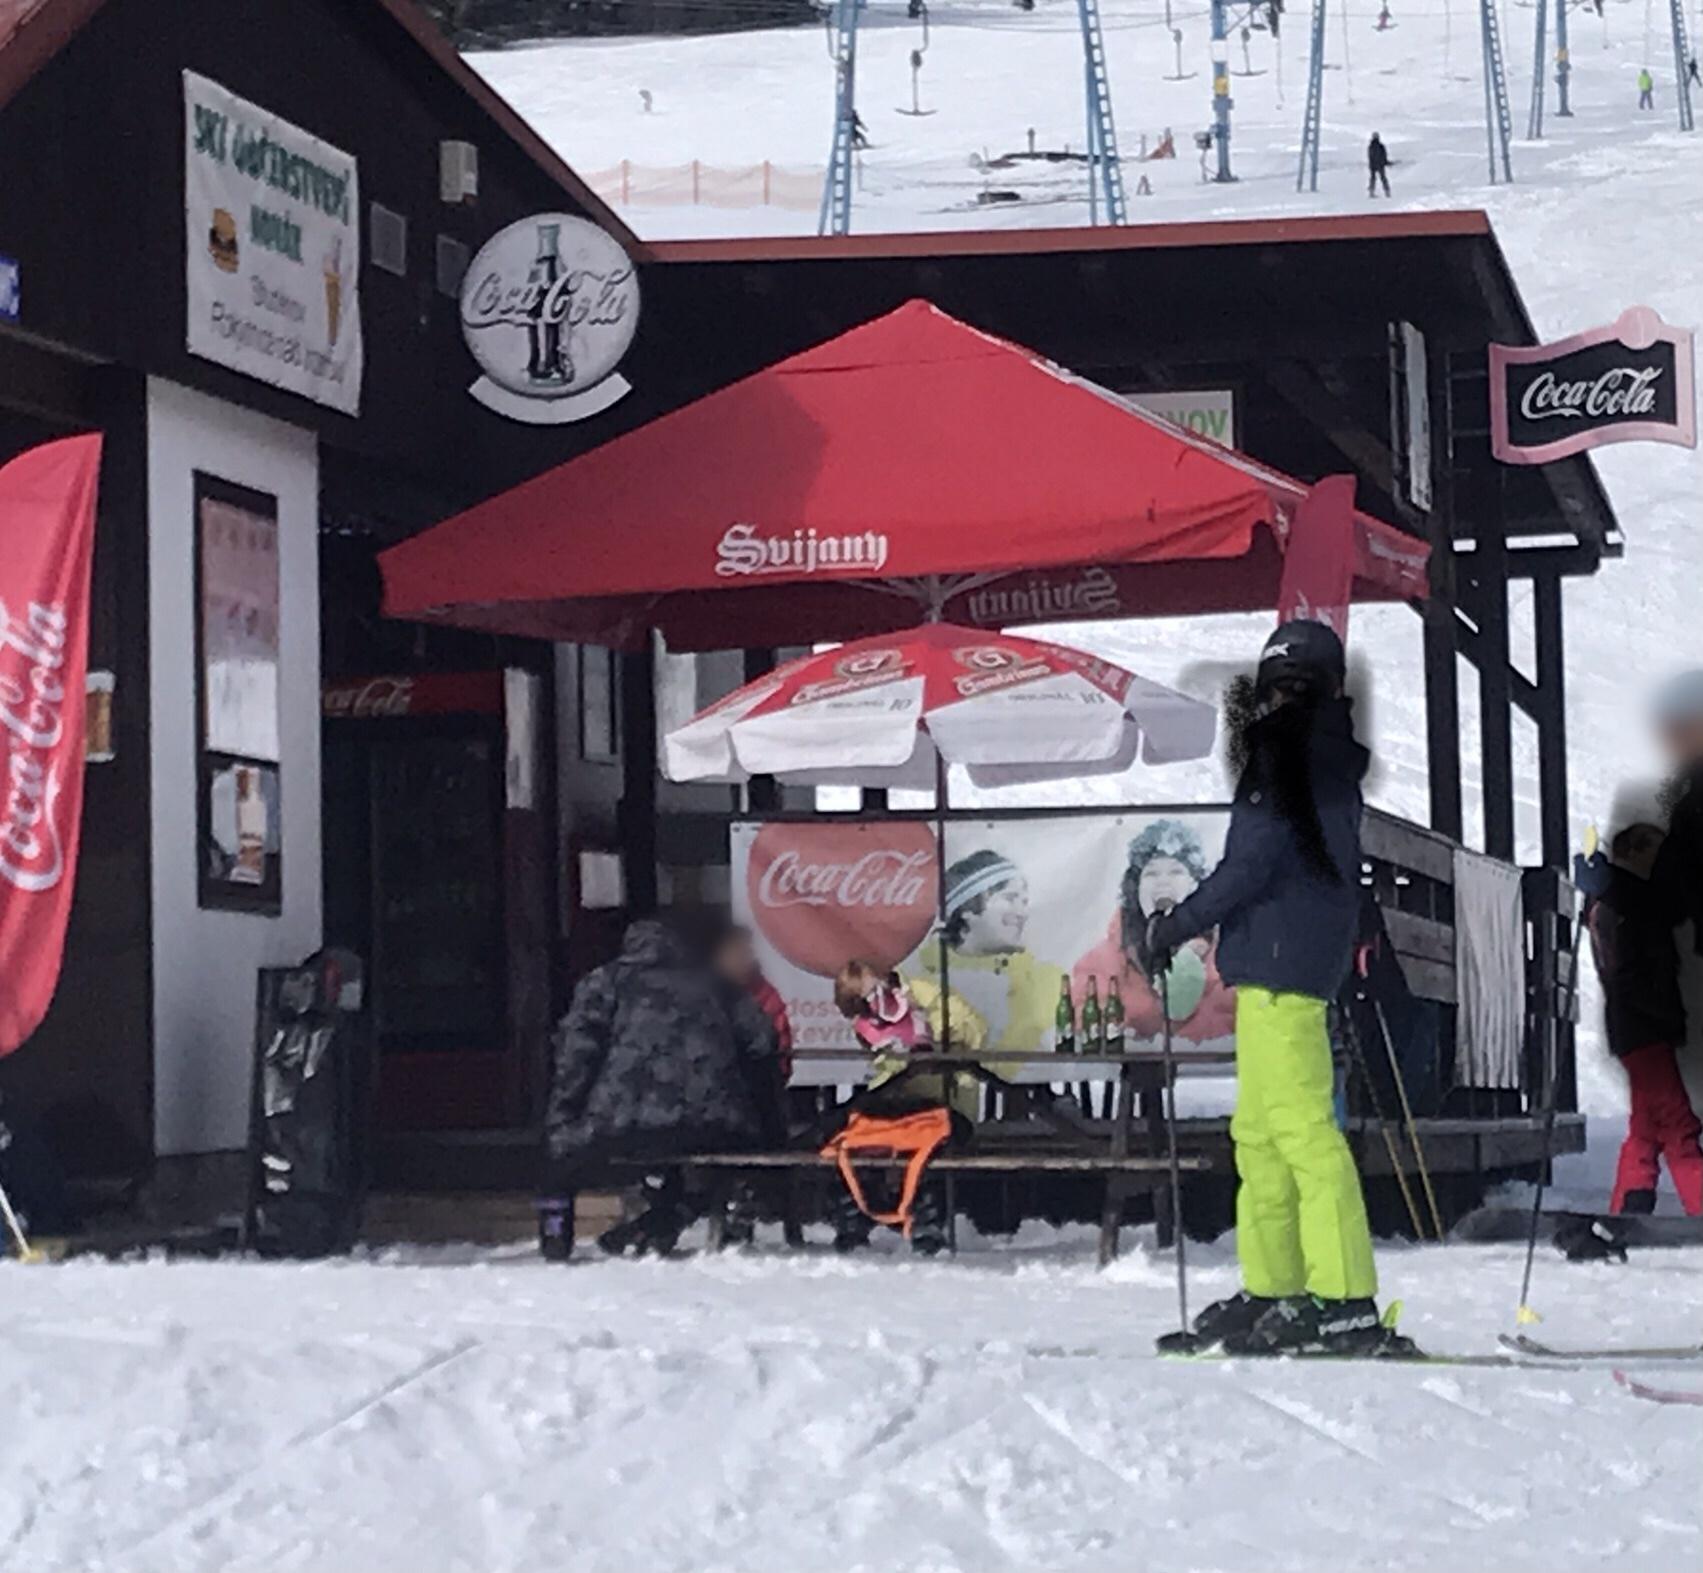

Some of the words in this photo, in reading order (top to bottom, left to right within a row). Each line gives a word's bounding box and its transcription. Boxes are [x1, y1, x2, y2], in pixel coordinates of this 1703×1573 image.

[194, 104, 228, 164] SKI
[462, 268, 634, 328] Coca-Cola
[1521, 366, 1662, 419] Coca-Cola
[715, 524, 888, 576] Svijany
[757, 850, 934, 908] Coca-Cola
